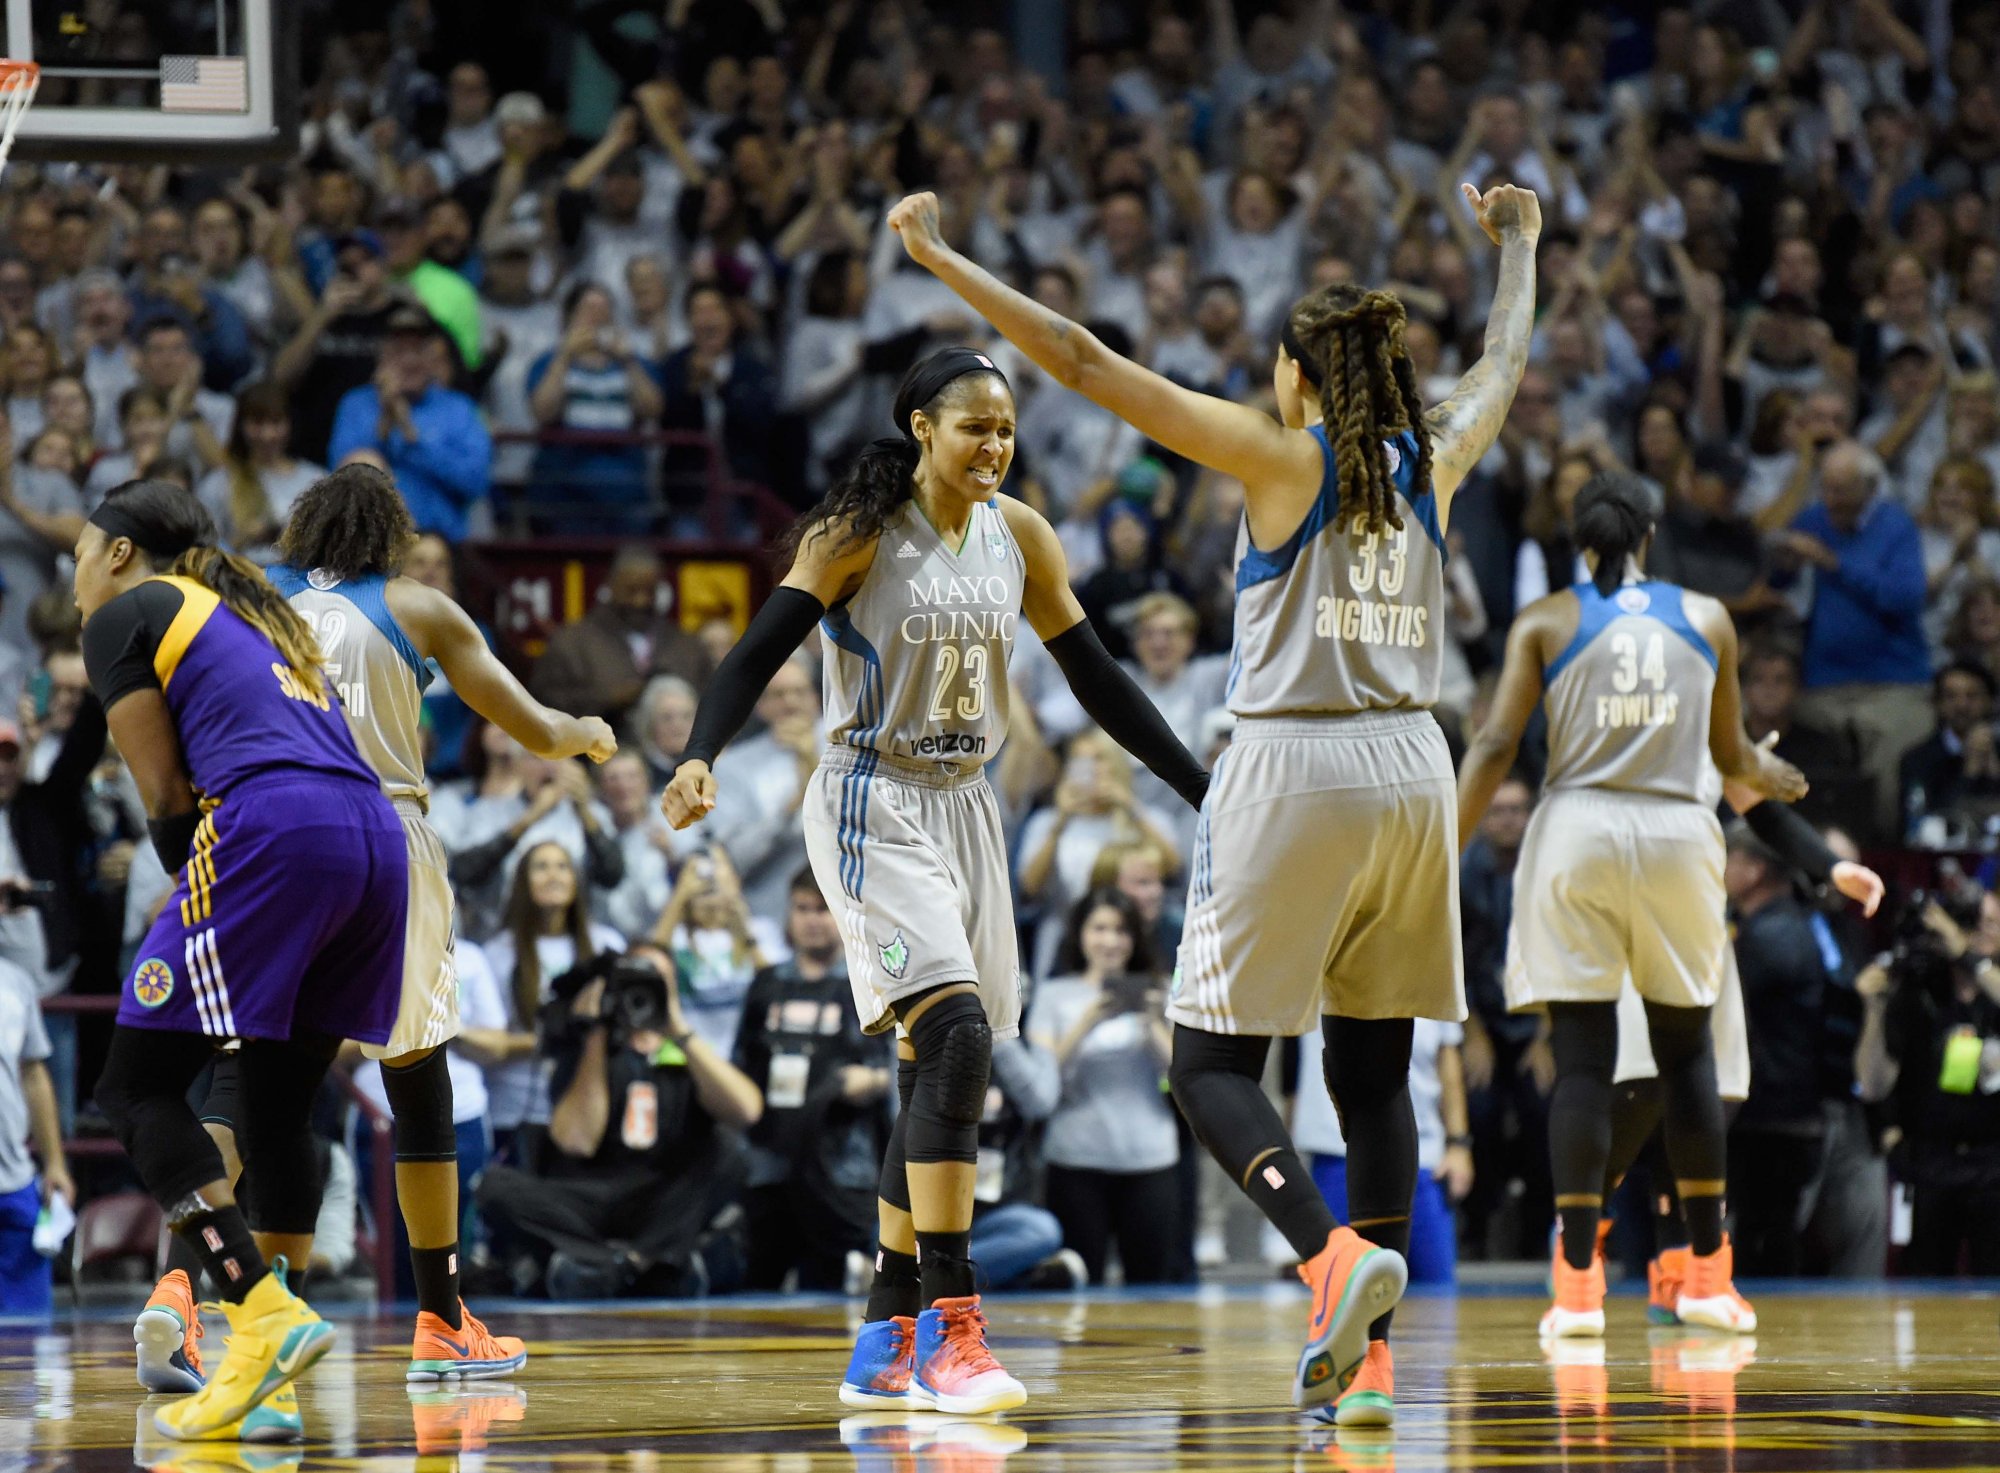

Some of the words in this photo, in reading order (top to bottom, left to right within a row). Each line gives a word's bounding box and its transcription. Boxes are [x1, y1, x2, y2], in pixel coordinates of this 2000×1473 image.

[1349, 511, 1408, 596] 33
[906, 575, 1008, 608] MAYO
[900, 610, 1015, 645] CLINIC
[928, 644, 988, 722] 23
[1611, 632, 1667, 693] 34
[911, 728, 985, 756] verizon
